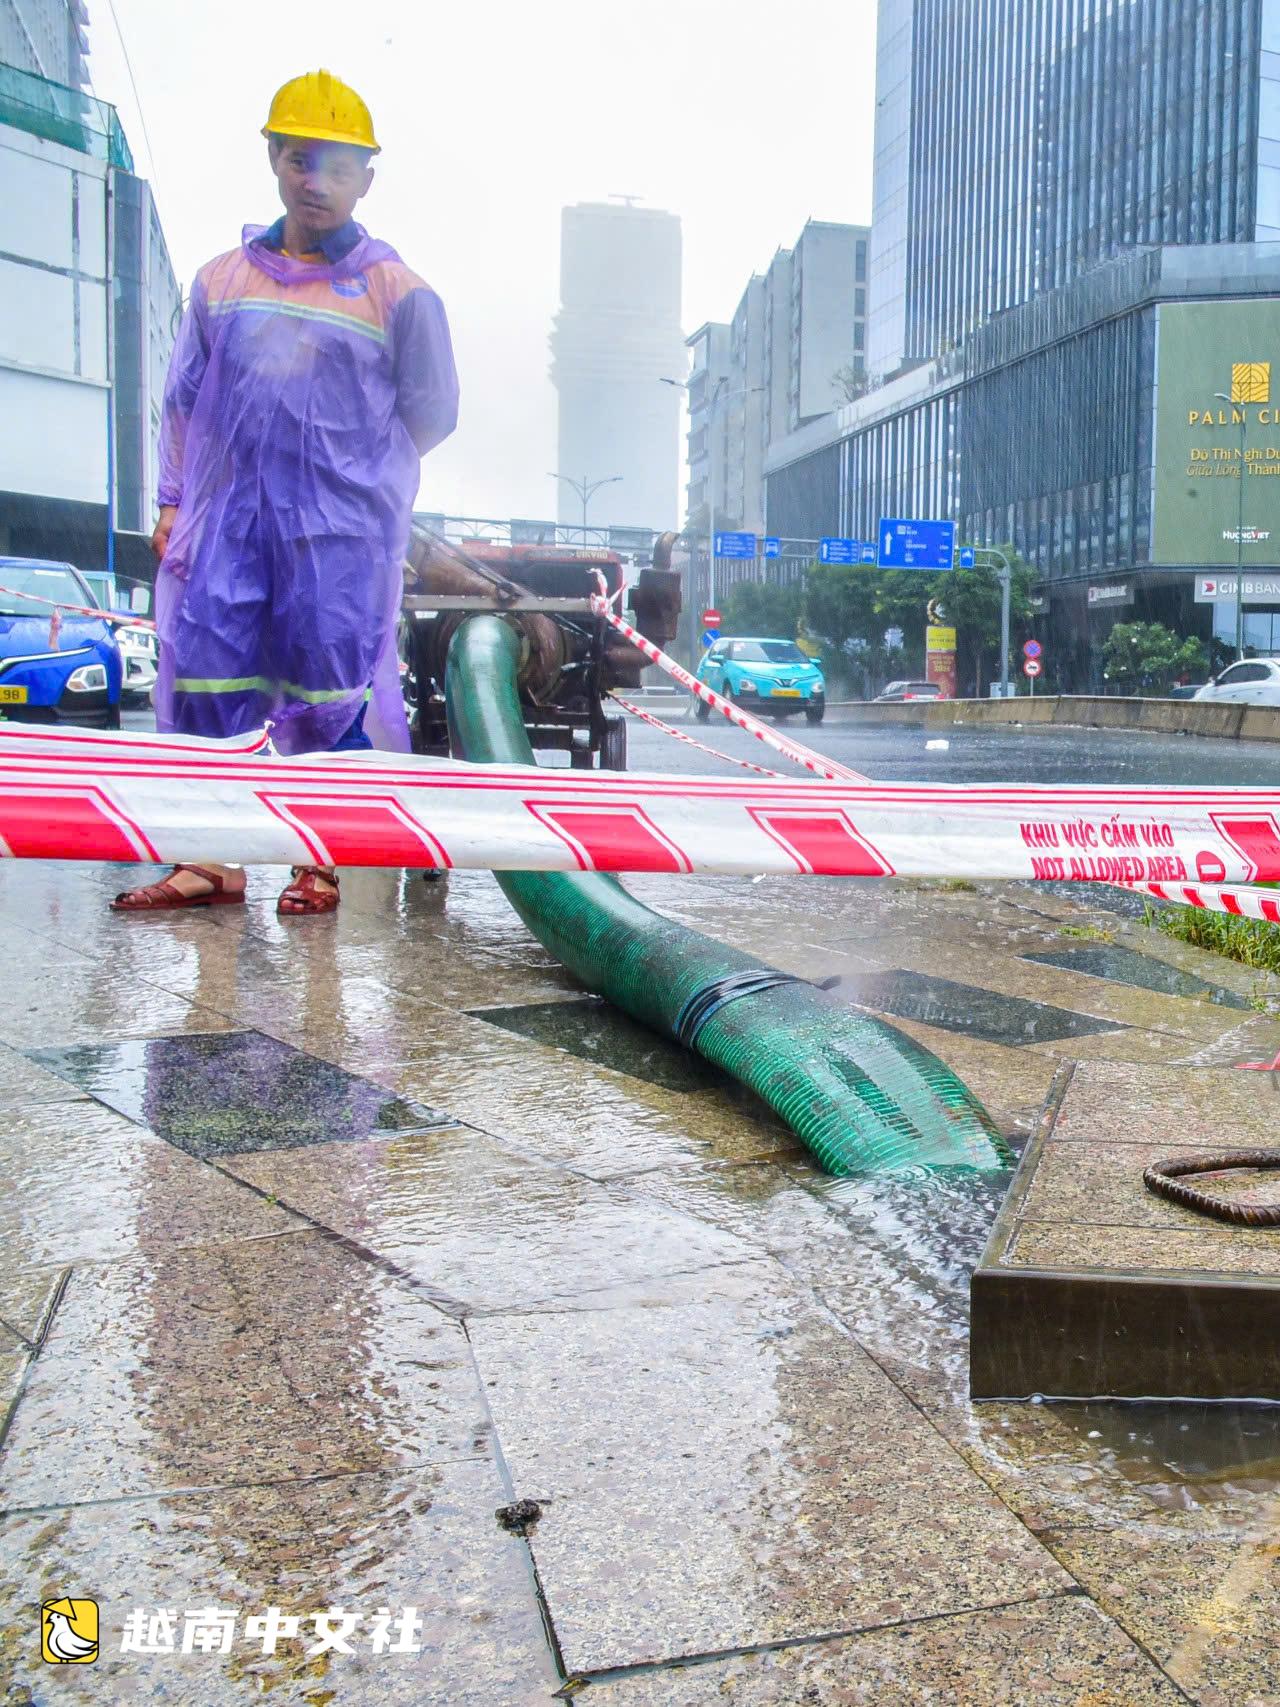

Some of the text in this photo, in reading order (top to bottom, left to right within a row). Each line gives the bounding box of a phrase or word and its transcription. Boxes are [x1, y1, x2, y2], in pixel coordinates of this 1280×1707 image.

[1188, 409, 1246, 425] PALM
[1019, 813, 1175, 852] KHU VỰC CẤM VÀO
[1030, 856, 1189, 881] NOT ALLOWED AREA
